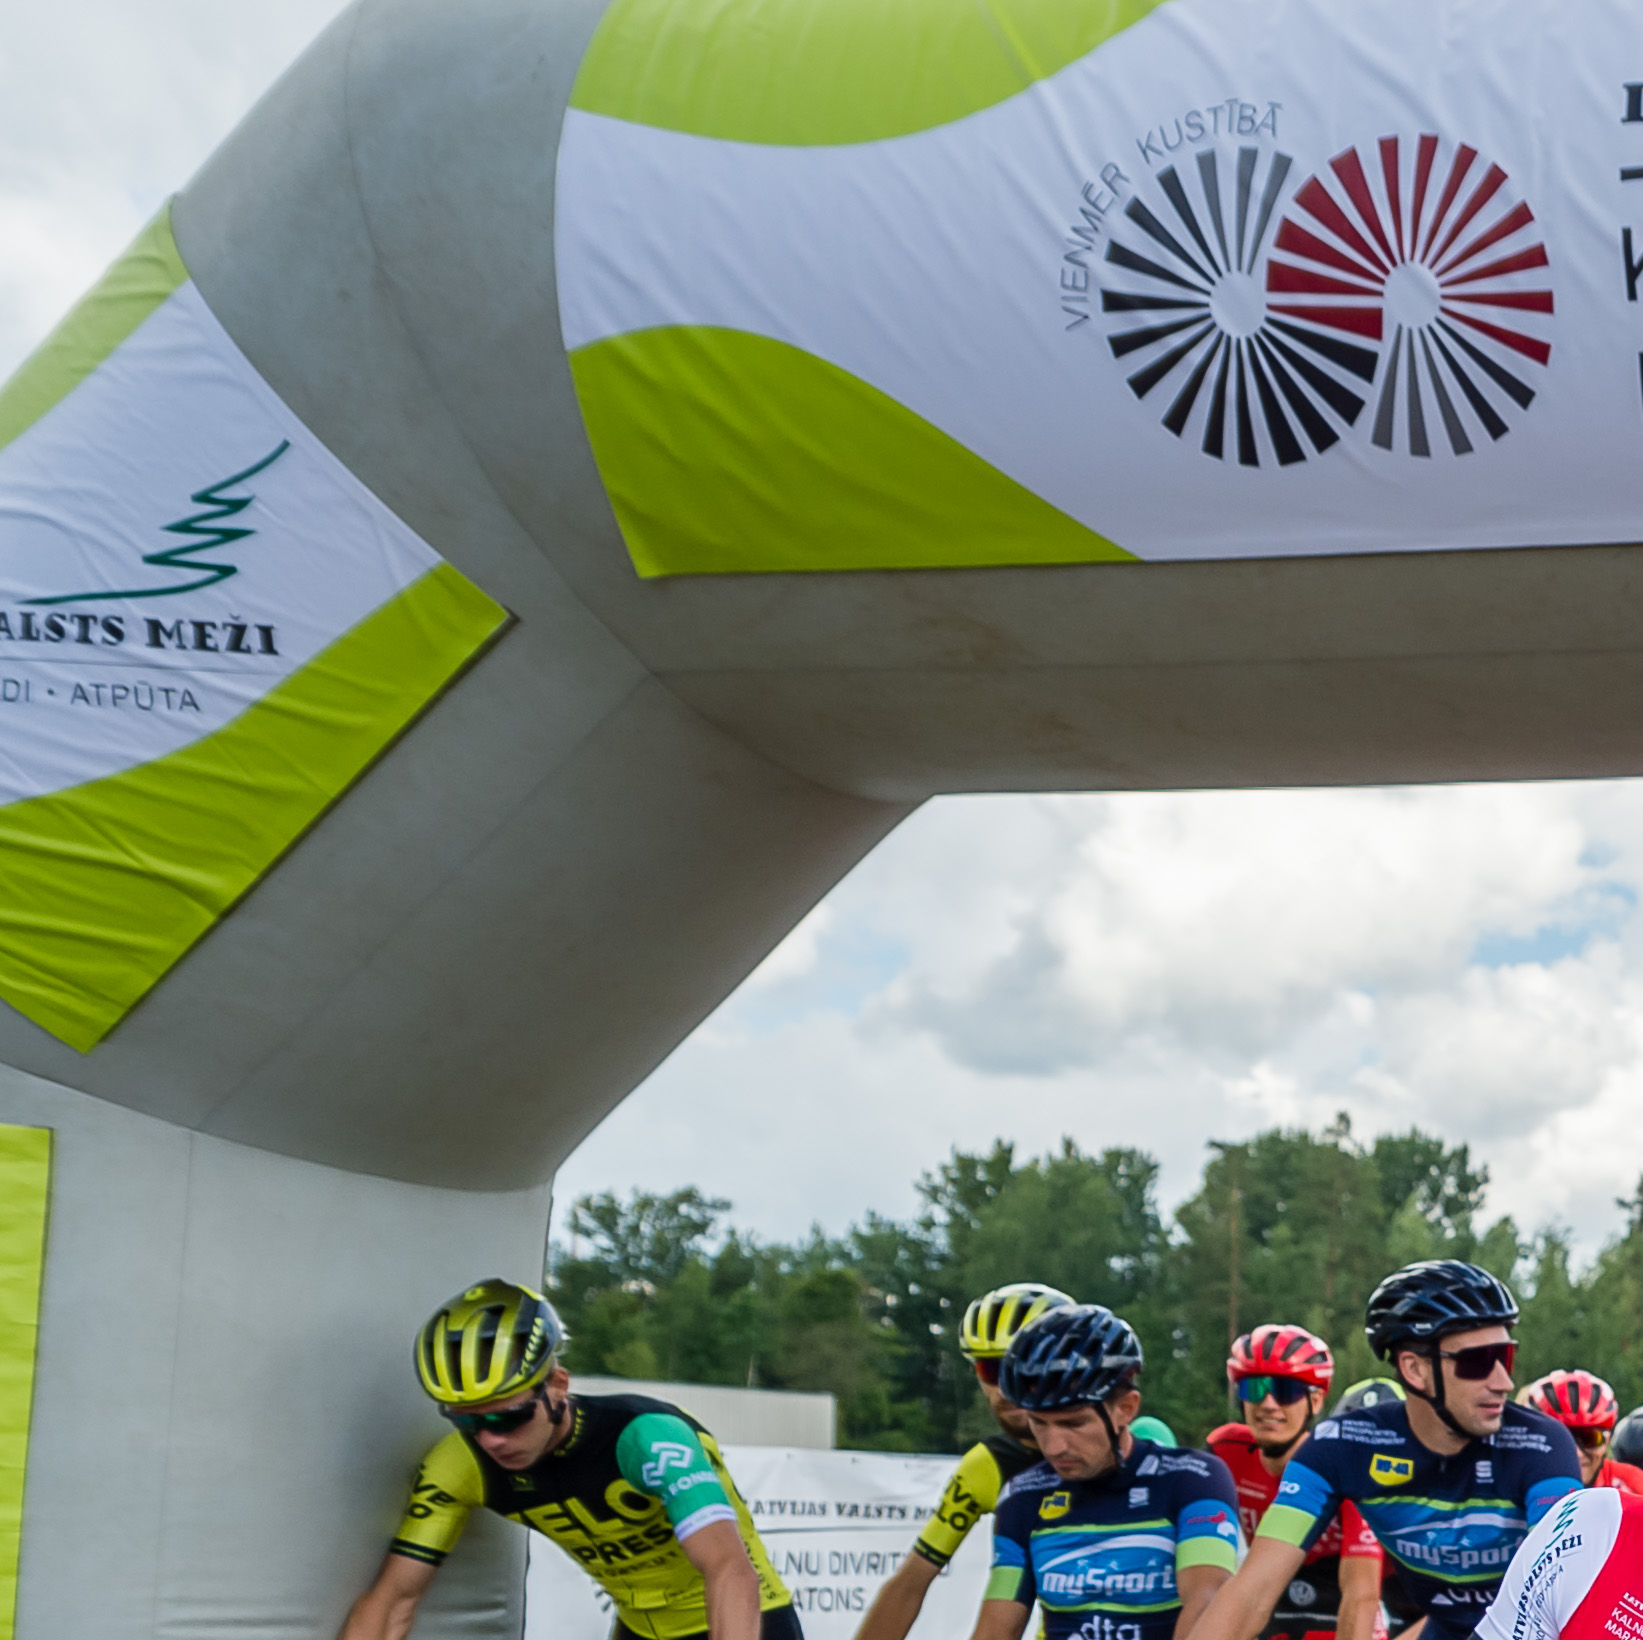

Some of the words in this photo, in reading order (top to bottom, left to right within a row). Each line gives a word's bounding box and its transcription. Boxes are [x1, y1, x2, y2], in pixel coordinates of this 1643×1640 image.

[1061, 161, 1132, 331] VIENMĒR
[1136, 98, 1283, 164] KUSTĪBĀ
[143, 613, 281, 656] MEŽI
[70, 680, 203, 712] ATPŪTA
